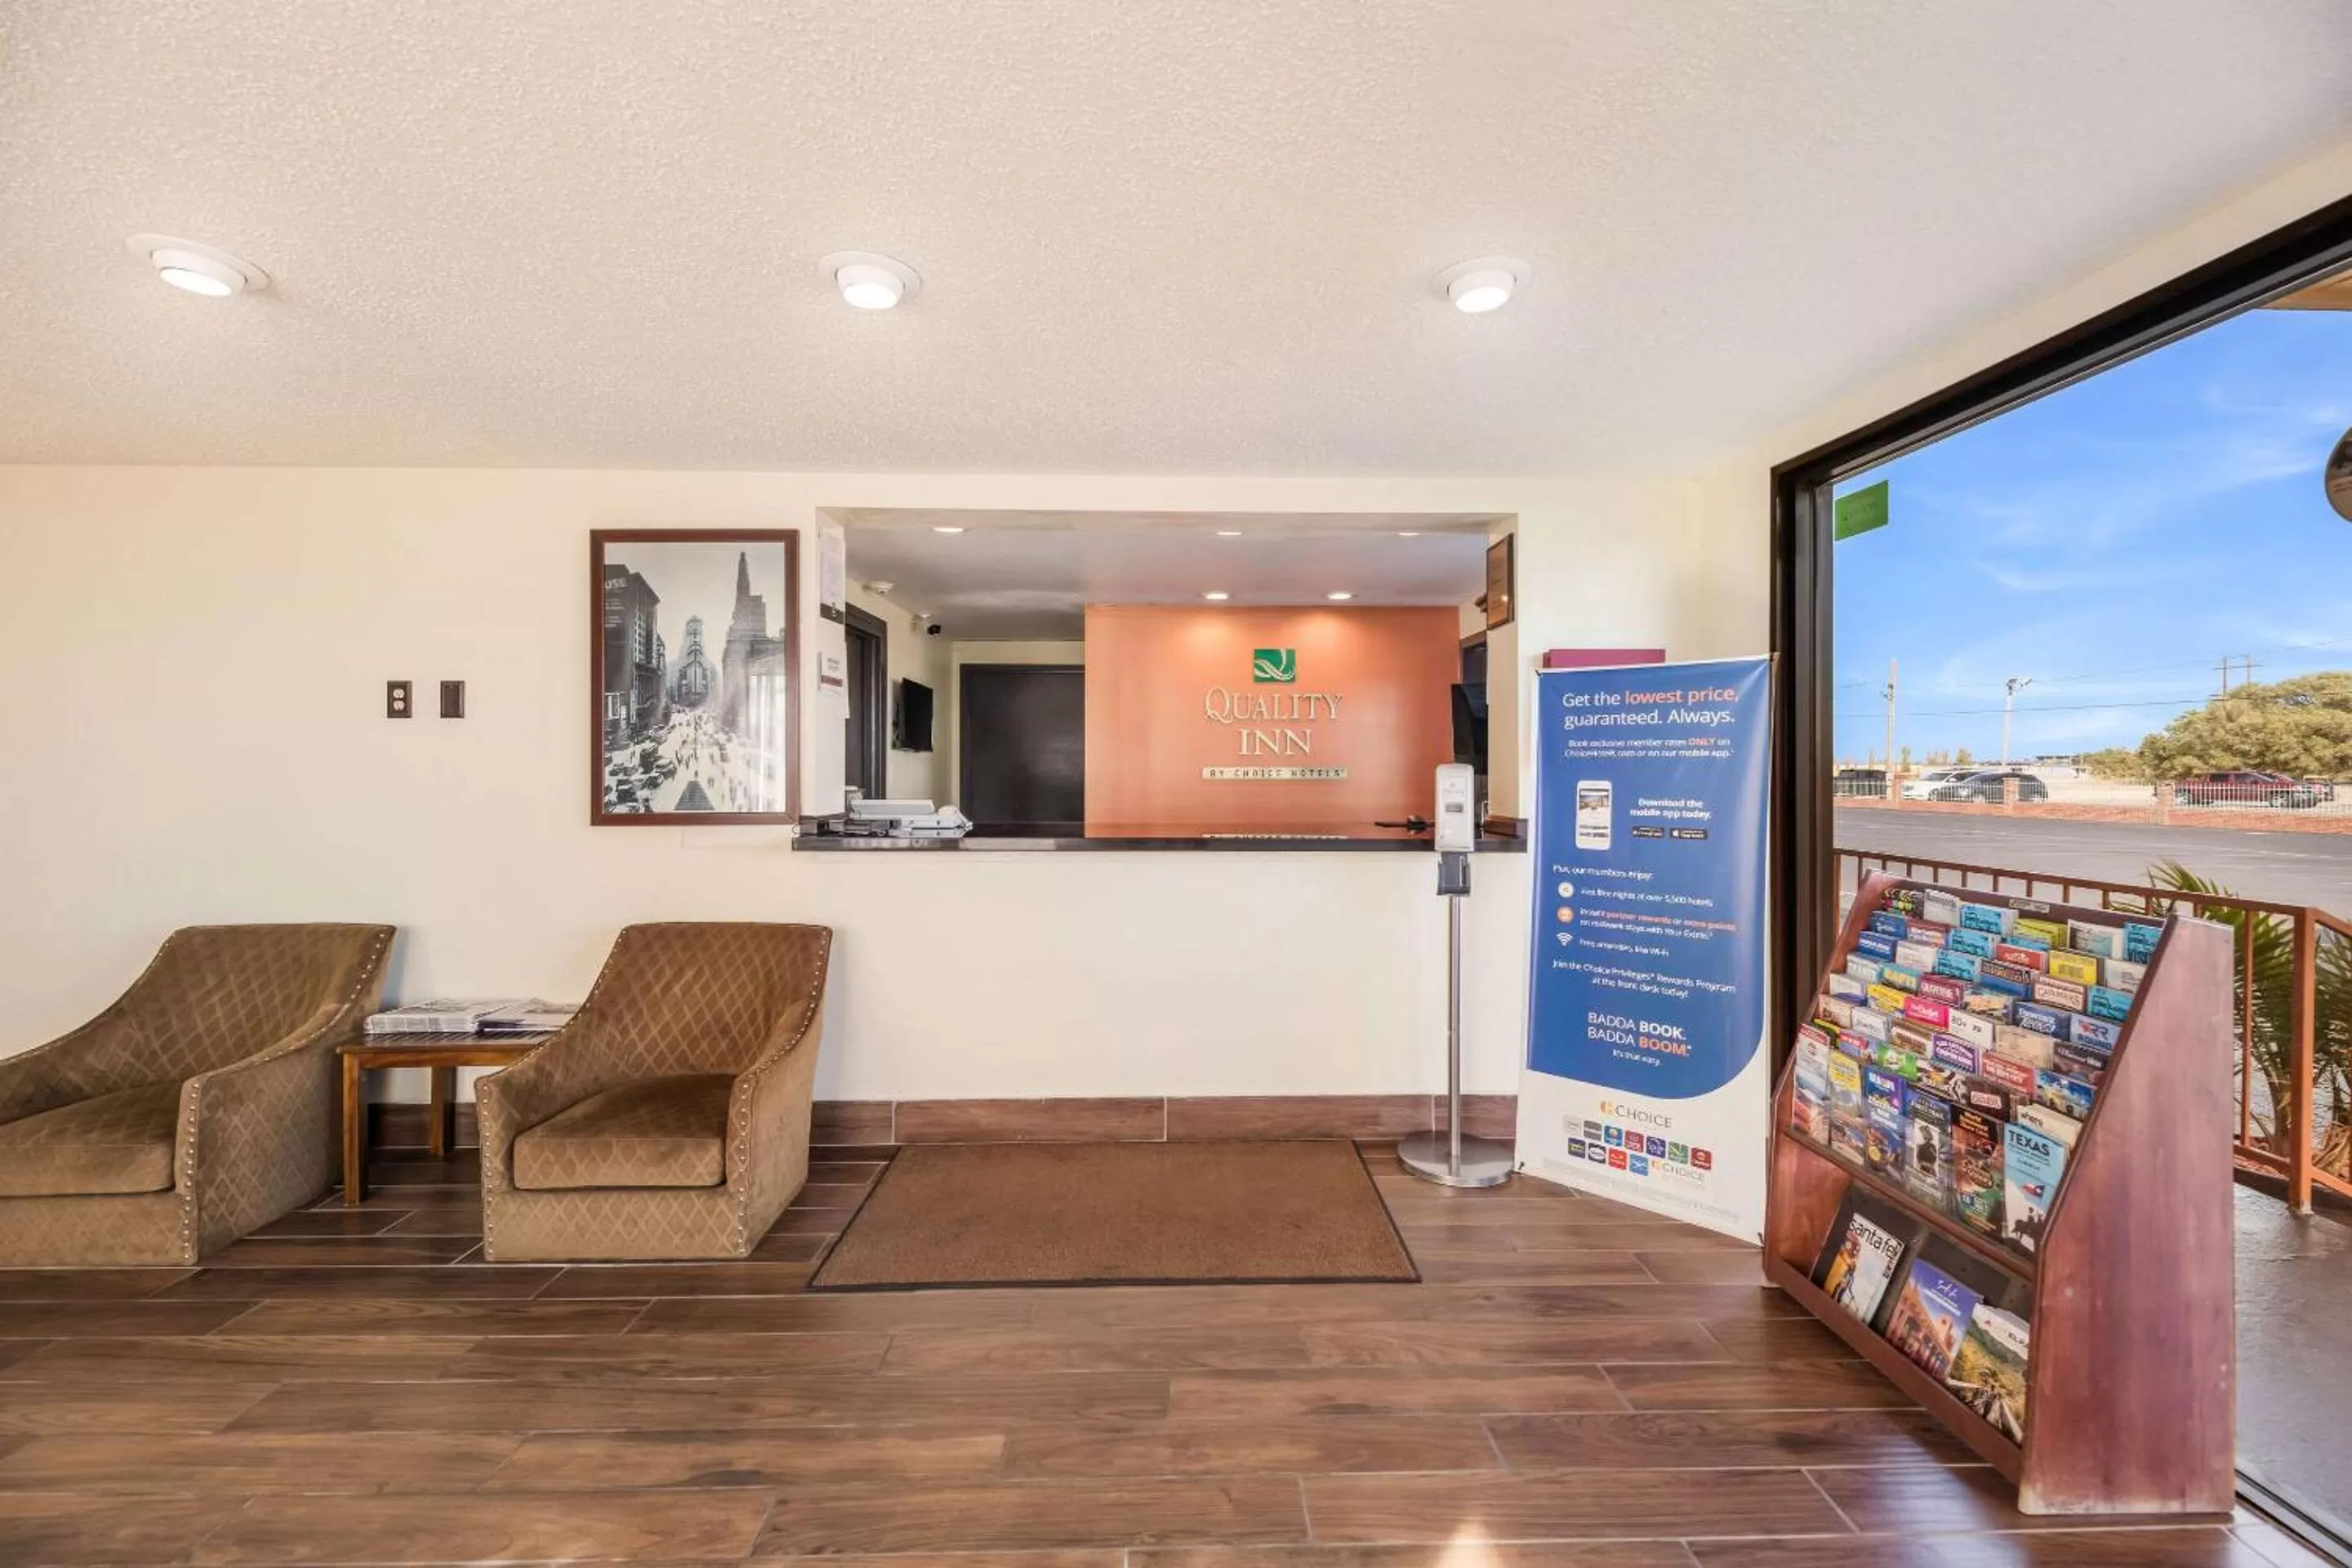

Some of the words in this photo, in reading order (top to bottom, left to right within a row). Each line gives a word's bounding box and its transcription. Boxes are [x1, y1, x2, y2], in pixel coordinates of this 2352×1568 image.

[1204, 686, 1343, 724] QUALITY
[1562, 692, 1591, 707] Get
[1594, 691, 1620, 706] the
[1624, 689, 1683, 705] lowest
[1687, 686, 1740, 706] price,
[1564, 708, 1663, 730] guaranteed.
[1667, 708, 1735, 727] Always.
[1238, 728, 1312, 755] INN
[1688, 737, 1716, 746] ONLY
[1209, 769, 1224, 777] BY
[1235, 769, 1285, 777] CHOICE
[1292, 769, 1342, 777] HOTELS
[1637, 798, 1685, 807] Download
[1686, 799, 1704, 808] the
[1629, 808, 1661, 817] mobile
[1662, 809, 1681, 820] app
[1695, 979, 1737, 994] Program
[1587, 1011, 1636, 1031] BADDA
[1638, 1020, 1687, 1041] BOOK.
[1587, 1026, 1635, 1046] BADDA
[1615, 1104, 1673, 1129] CHOICE
[2007, 1129, 2051, 1156] TEXAS
[1661, 1161, 1705, 1182] CHOICE
[1849, 1219, 1882, 1250] santa
